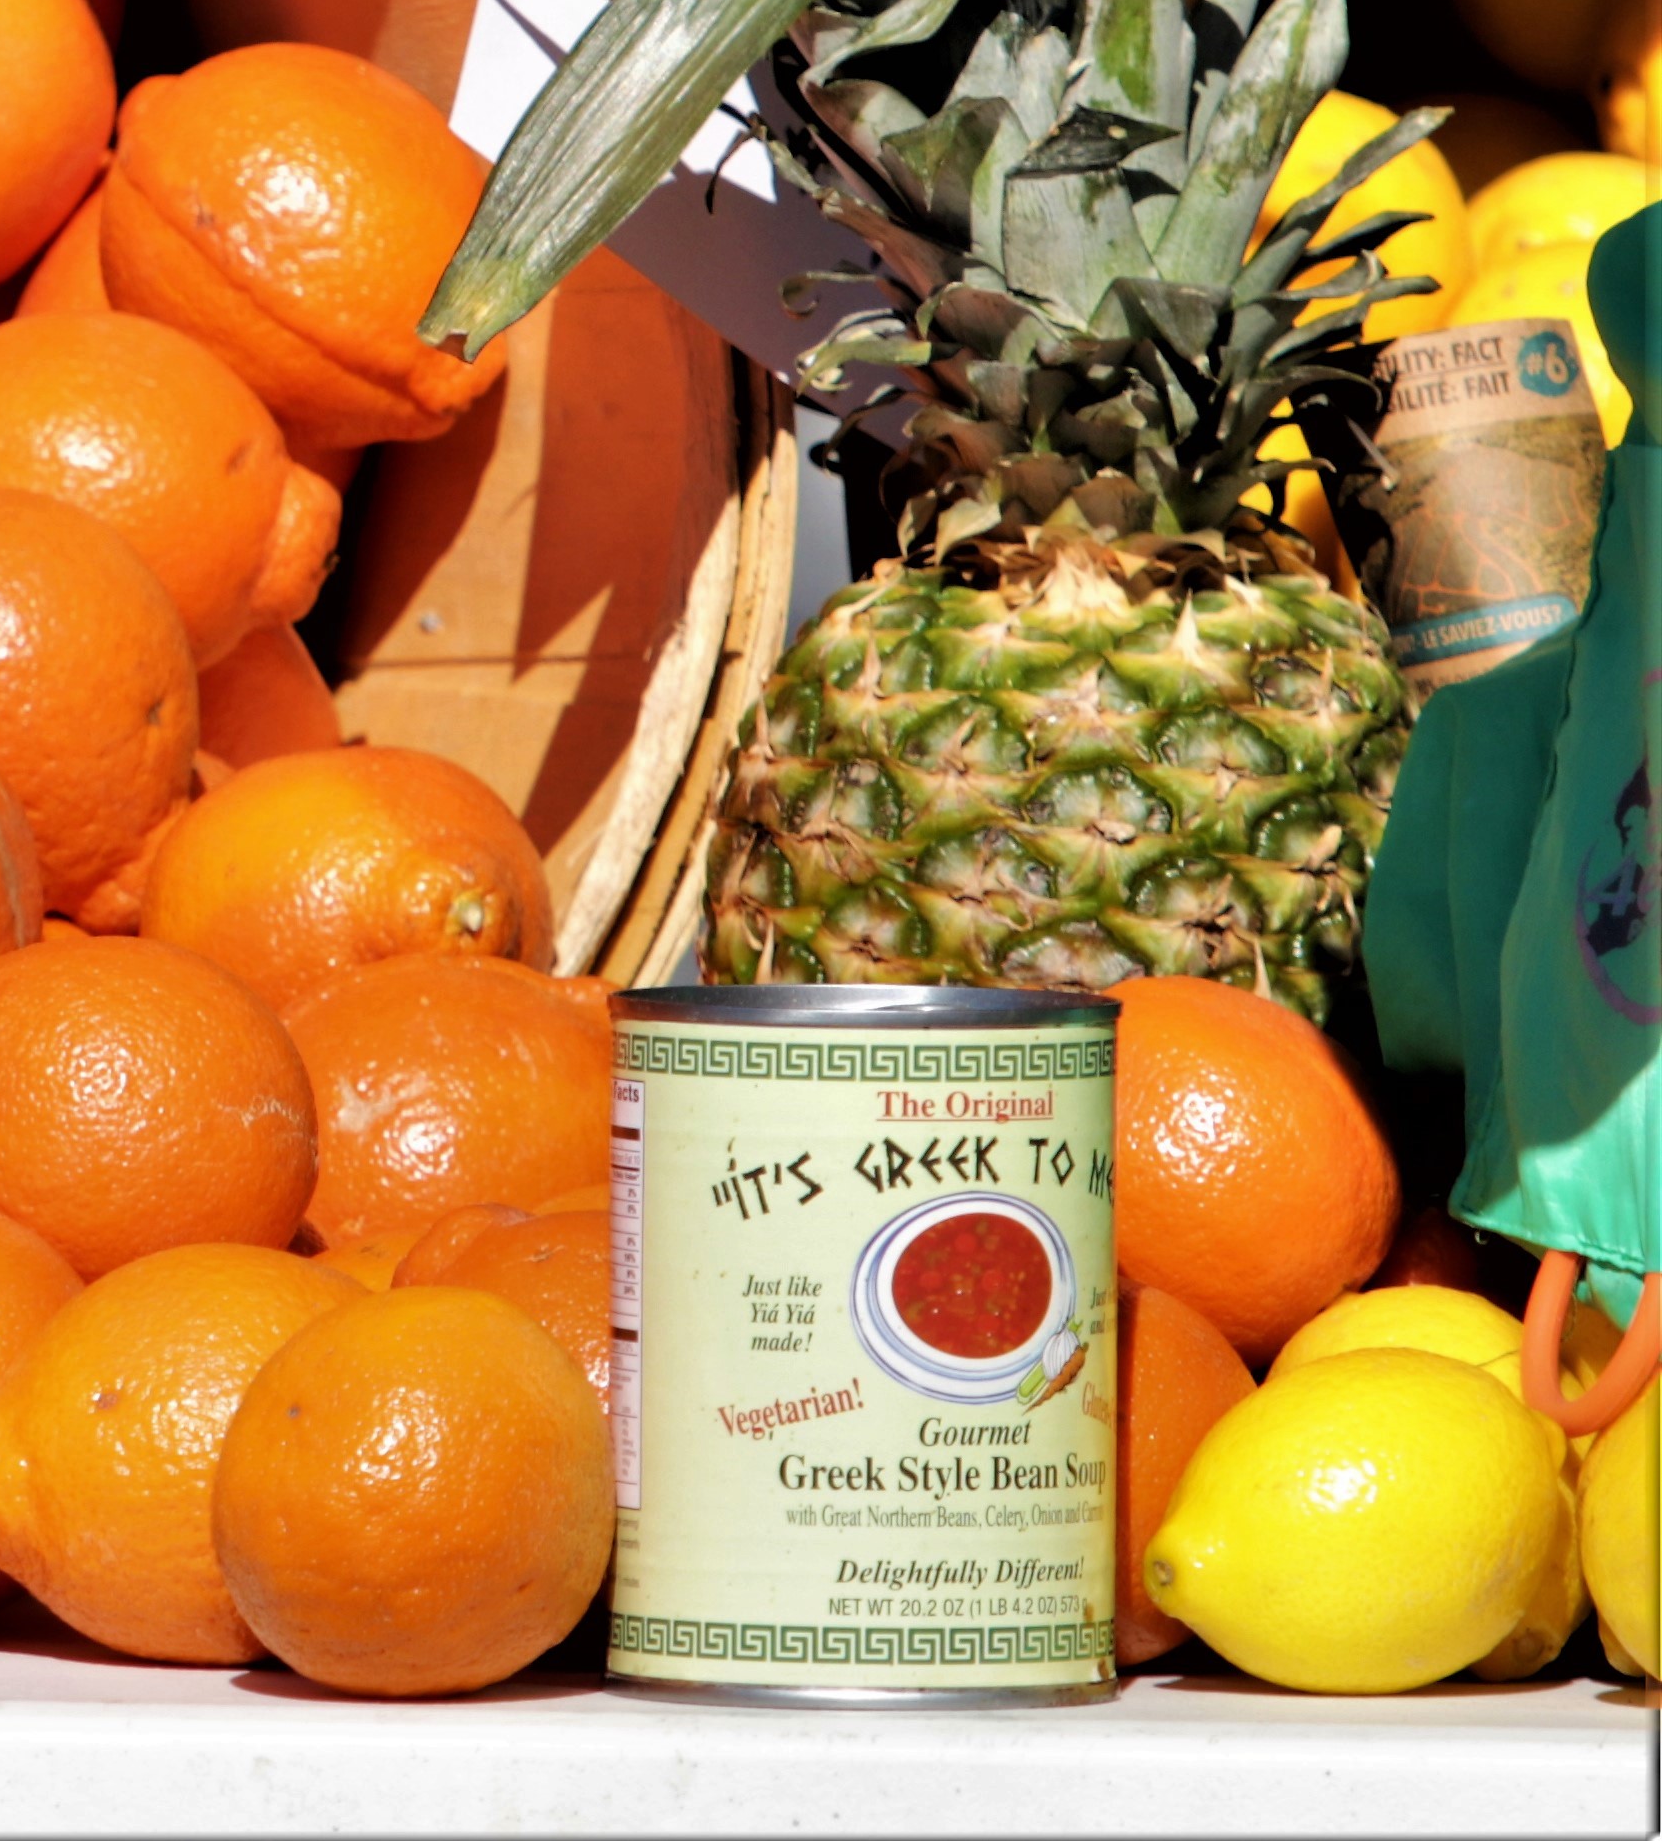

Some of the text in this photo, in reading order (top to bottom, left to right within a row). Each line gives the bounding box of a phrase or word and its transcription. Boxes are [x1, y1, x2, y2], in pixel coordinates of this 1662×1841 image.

[1451, 336, 1505, 366] FACT
[1526, 342, 1570, 384] #6
[1464, 371, 1511, 399] FAIT
[1439, 604, 1562, 644] SAVIEZ-VOUS?
[877, 1090, 1053, 1124] The Original
[854, 1136, 1000, 1193] GREEK
[1029, 1138, 1075, 1186] TO
[742, 1275, 823, 1297] Just like
[751, 1332, 813, 1352] made!
[718, 1377, 864, 1440] Vegetarian!
[919, 1417, 1032, 1447] Gourmet
[778, 1452, 1106, 1500] Greek Style Bean Soup
[786, 1504, 817, 1527] with
[822, 1504, 862, 1528] Great
[867, 1505, 932, 1528] Northern
[937, 1505, 982, 1529] Beans,
[985, 1504, 1029, 1532] Celery,
[1031, 1503, 1063, 1525] Onion
[836, 1556, 1085, 1590] Delightfully Different!
[829, 1598, 861, 1616] NET
[868, 1599, 893, 1616] WT
[900, 1599, 937, 1617] 20.2
[943, 1598, 964, 1617] OZ
[970, 1597, 981, 1619] (1
[989, 1597, 1007, 1616] LB
[1012, 1597, 1034, 1615] 4.2
[1038, 1596, 1057, 1617] OZ)
[1060, 1595, 1079, 1613] 573
